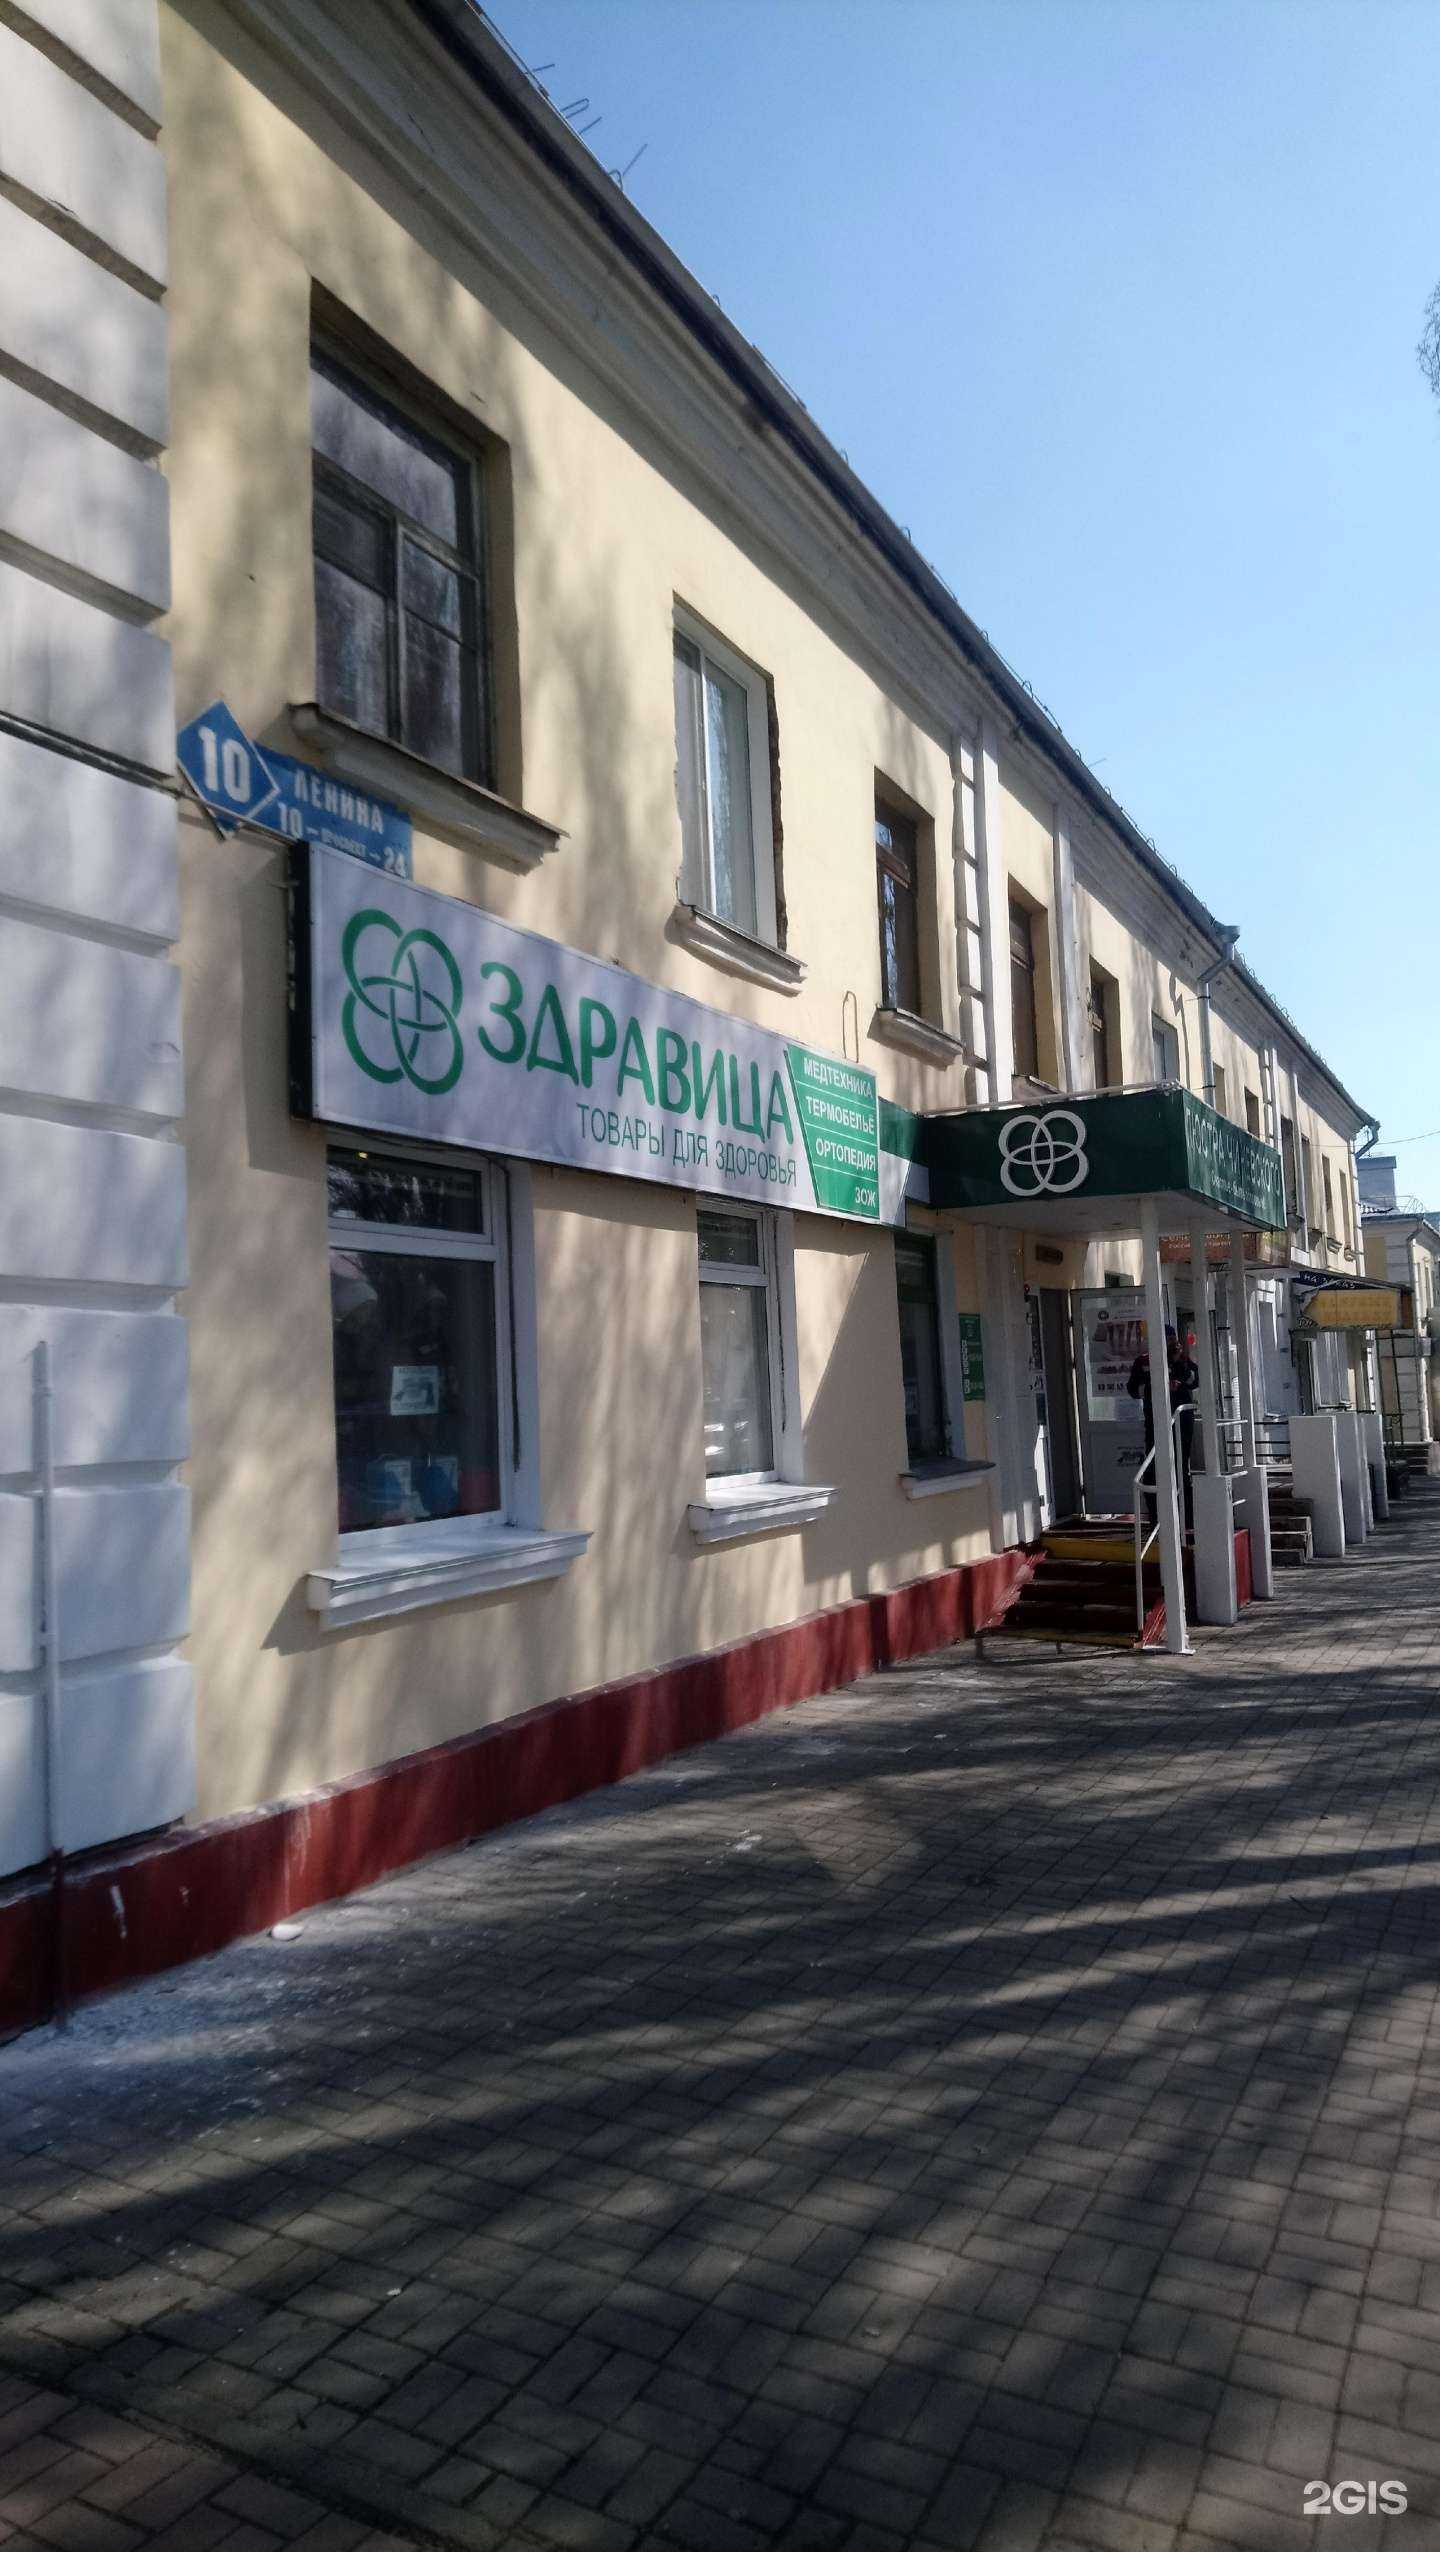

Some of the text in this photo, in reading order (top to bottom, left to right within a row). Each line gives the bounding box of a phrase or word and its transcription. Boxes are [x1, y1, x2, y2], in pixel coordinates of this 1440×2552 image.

[198, 726, 250, 803] 10
[278, 802, 303, 839] 10
[294, 769, 383, 834] ЛЕНИНА
[478, 961, 794, 1144] ЗДРАВИЦА
[804, 1057, 873, 1098] МЕДТЕХНИКА
[577, 1103, 797, 1187] ТОВАРЫ ДЛЯ ЗДОРОВЬЯ
[816, 1138, 875, 1172] ОРТОПЕДИЯ
[855, 1186, 876, 1208] ЗОЖ
